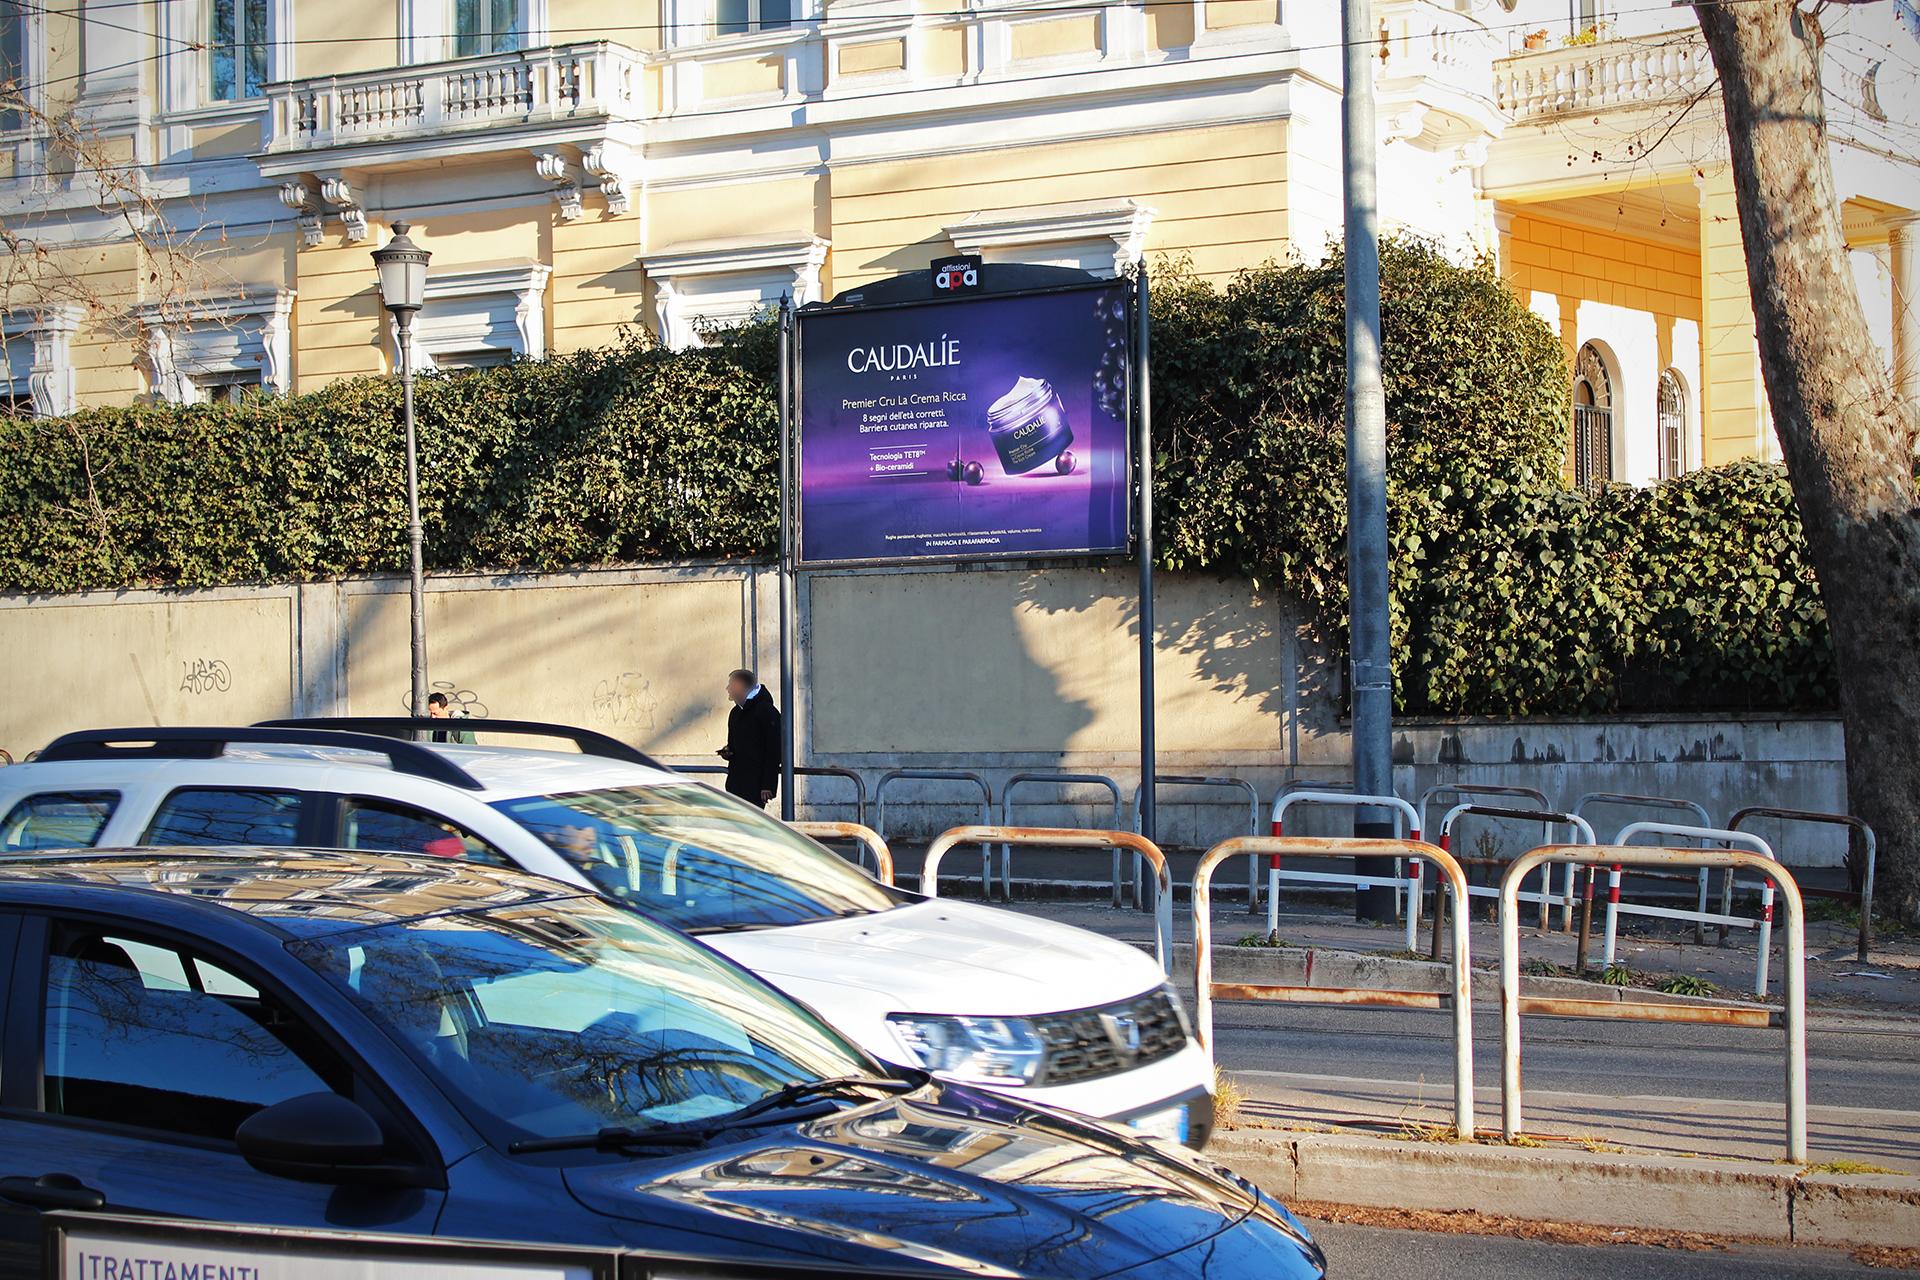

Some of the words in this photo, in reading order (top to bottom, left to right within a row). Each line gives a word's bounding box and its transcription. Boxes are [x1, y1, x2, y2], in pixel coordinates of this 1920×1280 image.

[941, 262, 971, 272] affissioni
[936, 269, 978, 290] apa
[847, 333, 961, 374] CAUDALÍE
[890, 373, 918, 381] PARIS
[842, 399, 877, 410] Premier
[879, 396, 896, 407] Cru
[898, 395, 908, 405] La
[910, 393, 940, 404] Crema
[942, 391, 967, 402] Ricca
[862, 413, 868, 422] 8
[869, 412, 888, 424] segni
[915, 408, 946, 419] corretti.
[859, 423, 888, 433] Barriera
[889, 422, 918, 431] cutanea
[919, 420, 949, 430] riparata.
[869, 451, 903, 461] Tecnologia
[875, 462, 914, 472] Bio-ceramidi
[962, 537, 1000, 545] PARAFARMACIA
